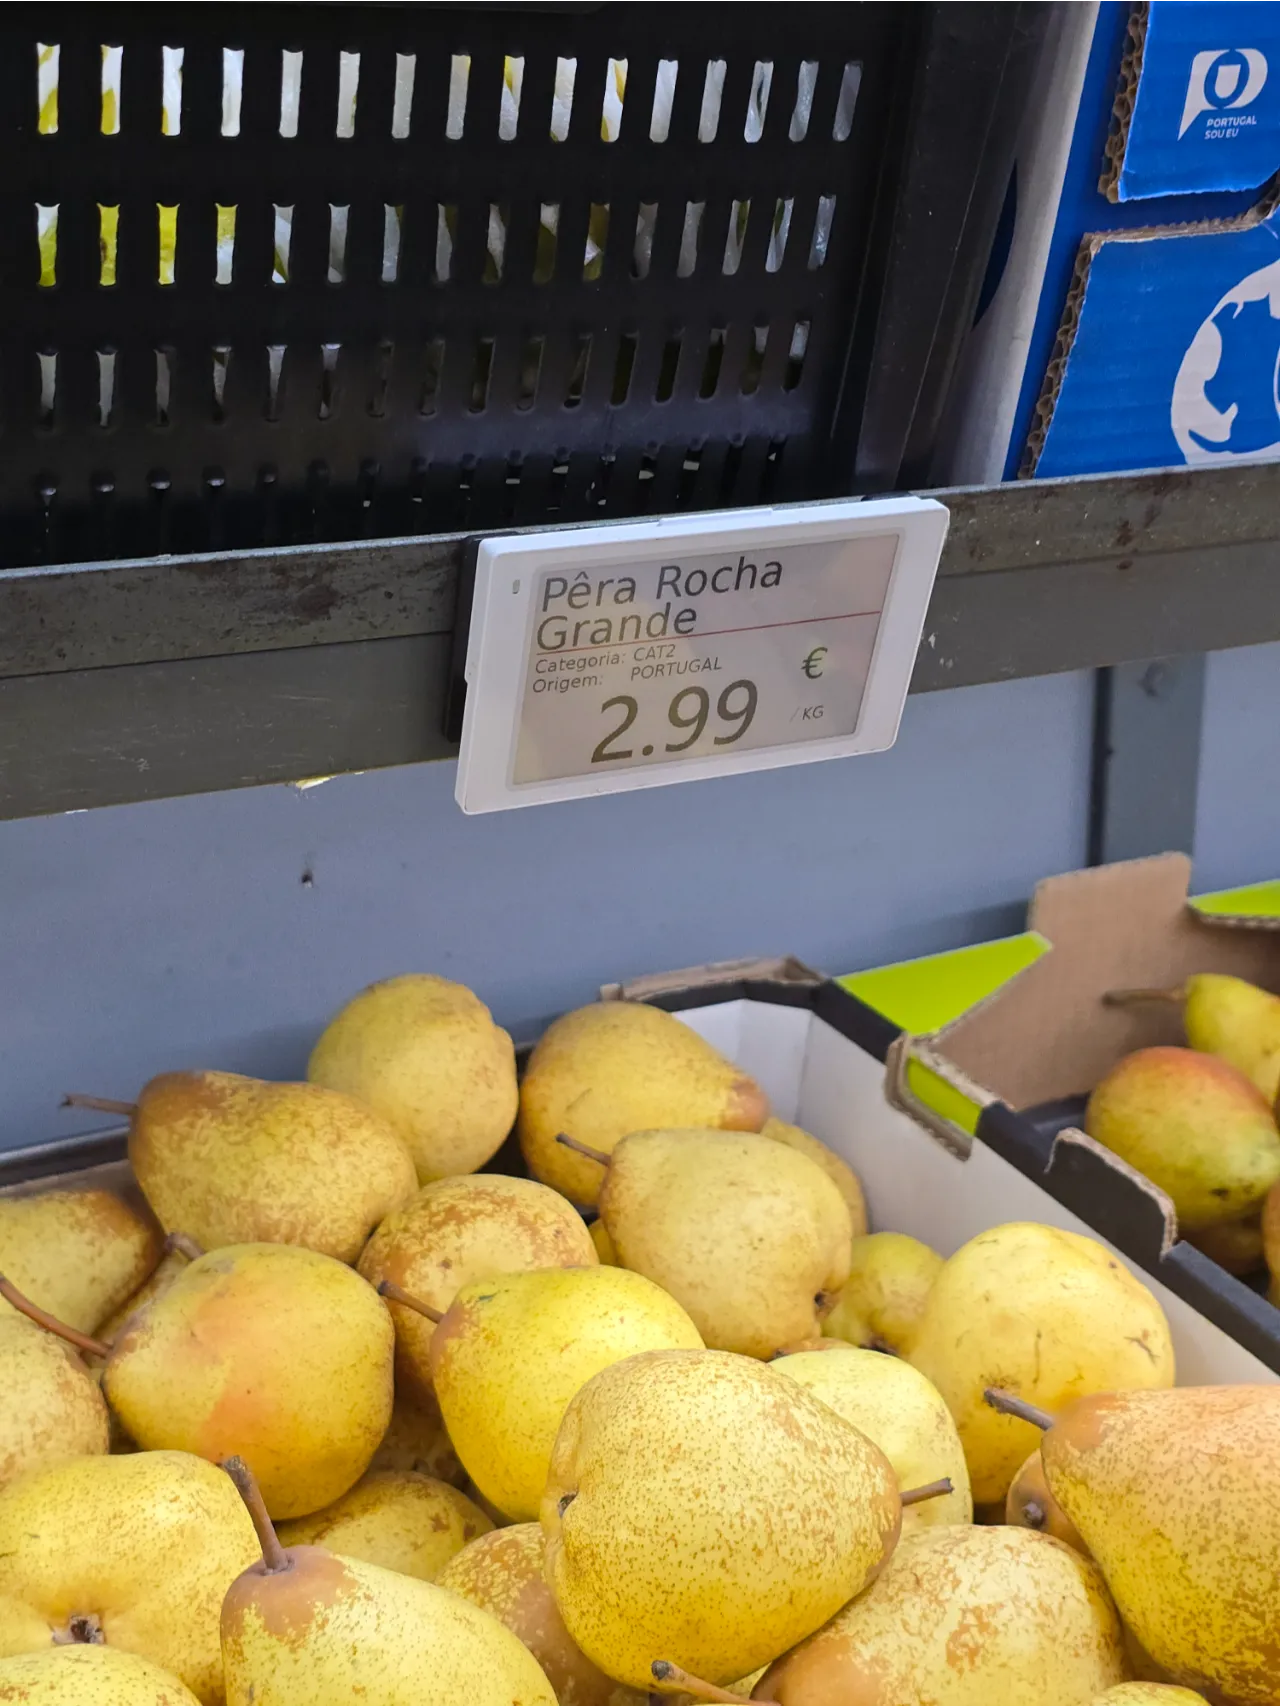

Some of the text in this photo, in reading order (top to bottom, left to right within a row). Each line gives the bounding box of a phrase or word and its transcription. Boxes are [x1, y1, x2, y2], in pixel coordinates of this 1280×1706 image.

[1204, 128, 1239, 139] SOU EU
[1206, 116, 1257, 127] PORTUGAL
[542, 555, 783, 612] Pêra Rocha
[537, 602, 698, 652] Grande
[532, 656, 722, 694] Origem: PORTUGAL
[534, 643, 676, 675] Categoria: CAT2
[801, 646, 828, 680] €
[590, 678, 759, 764] 2.99
